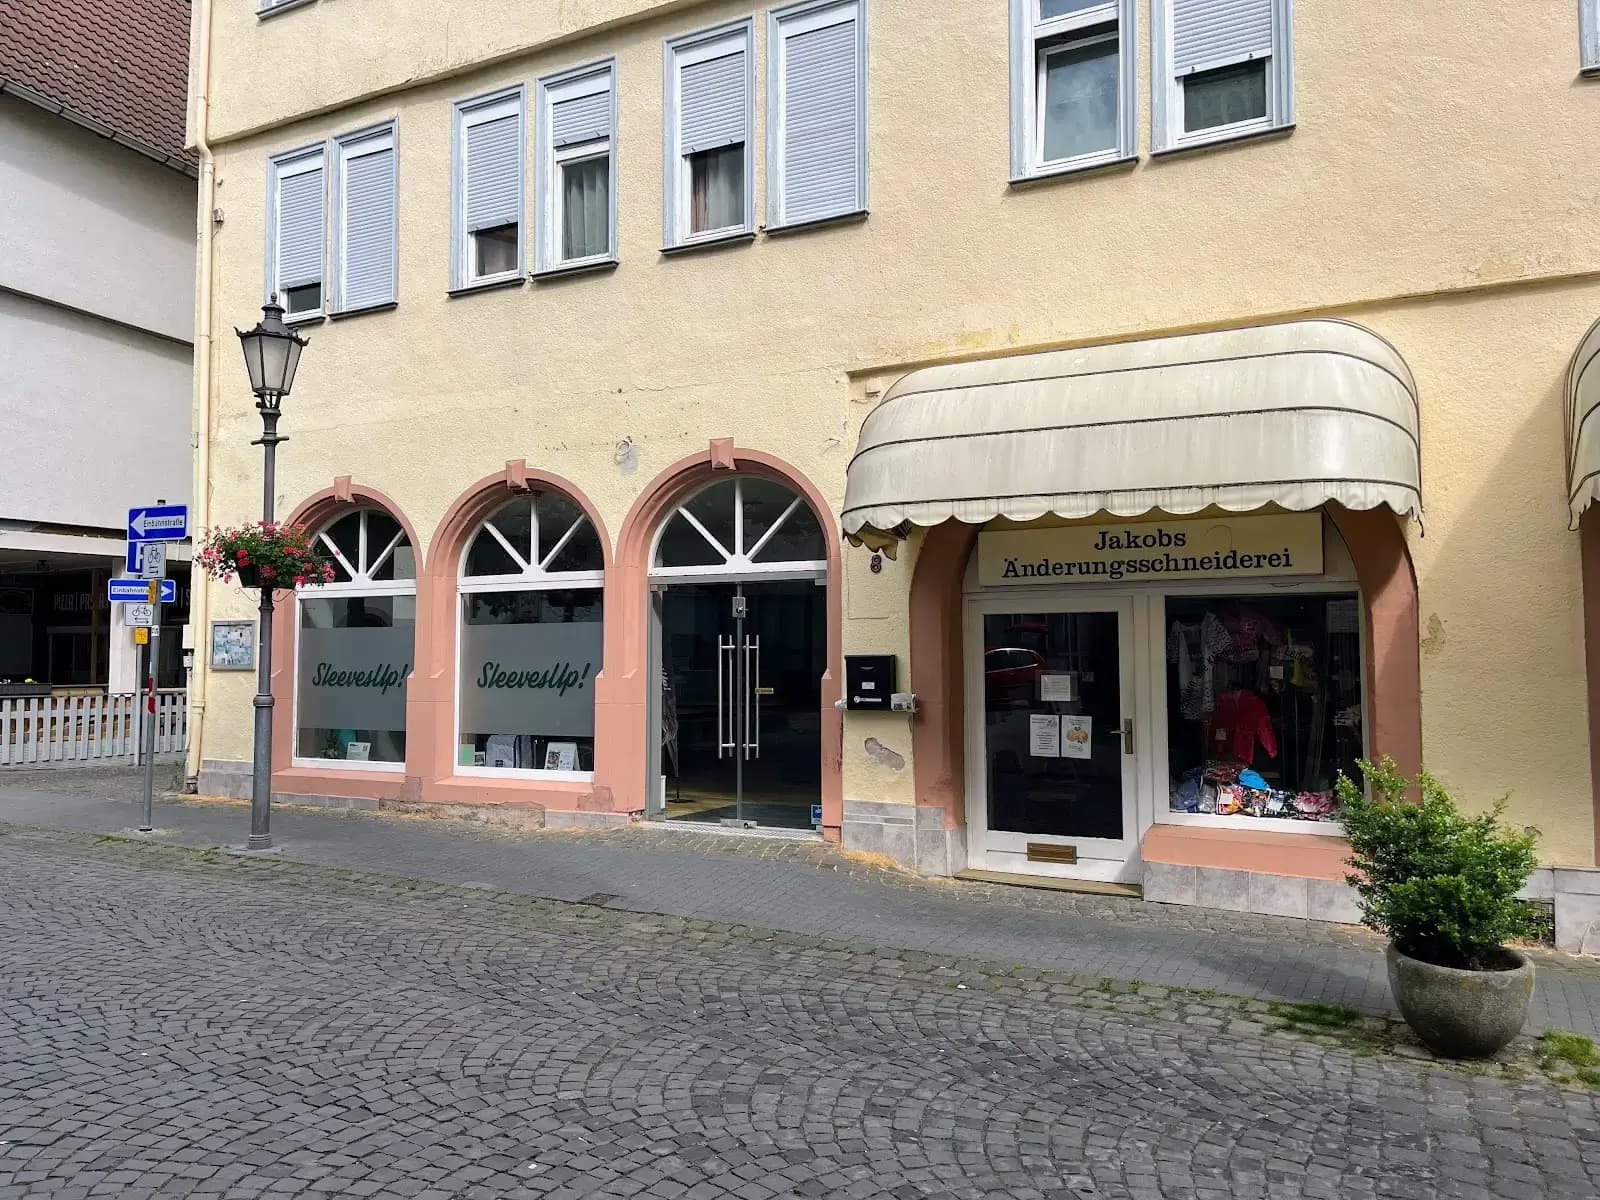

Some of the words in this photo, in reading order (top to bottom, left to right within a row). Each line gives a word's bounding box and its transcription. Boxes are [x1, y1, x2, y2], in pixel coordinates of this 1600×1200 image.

[143, 518, 183, 528] Einbahnstraße
[1094, 529, 1187, 550] Jakobs
[1002, 548, 1292, 579] Änderungsschneiderei
[312, 662, 408, 696] SleevesUp!
[477, 661, 591, 696] SleevesUp!
